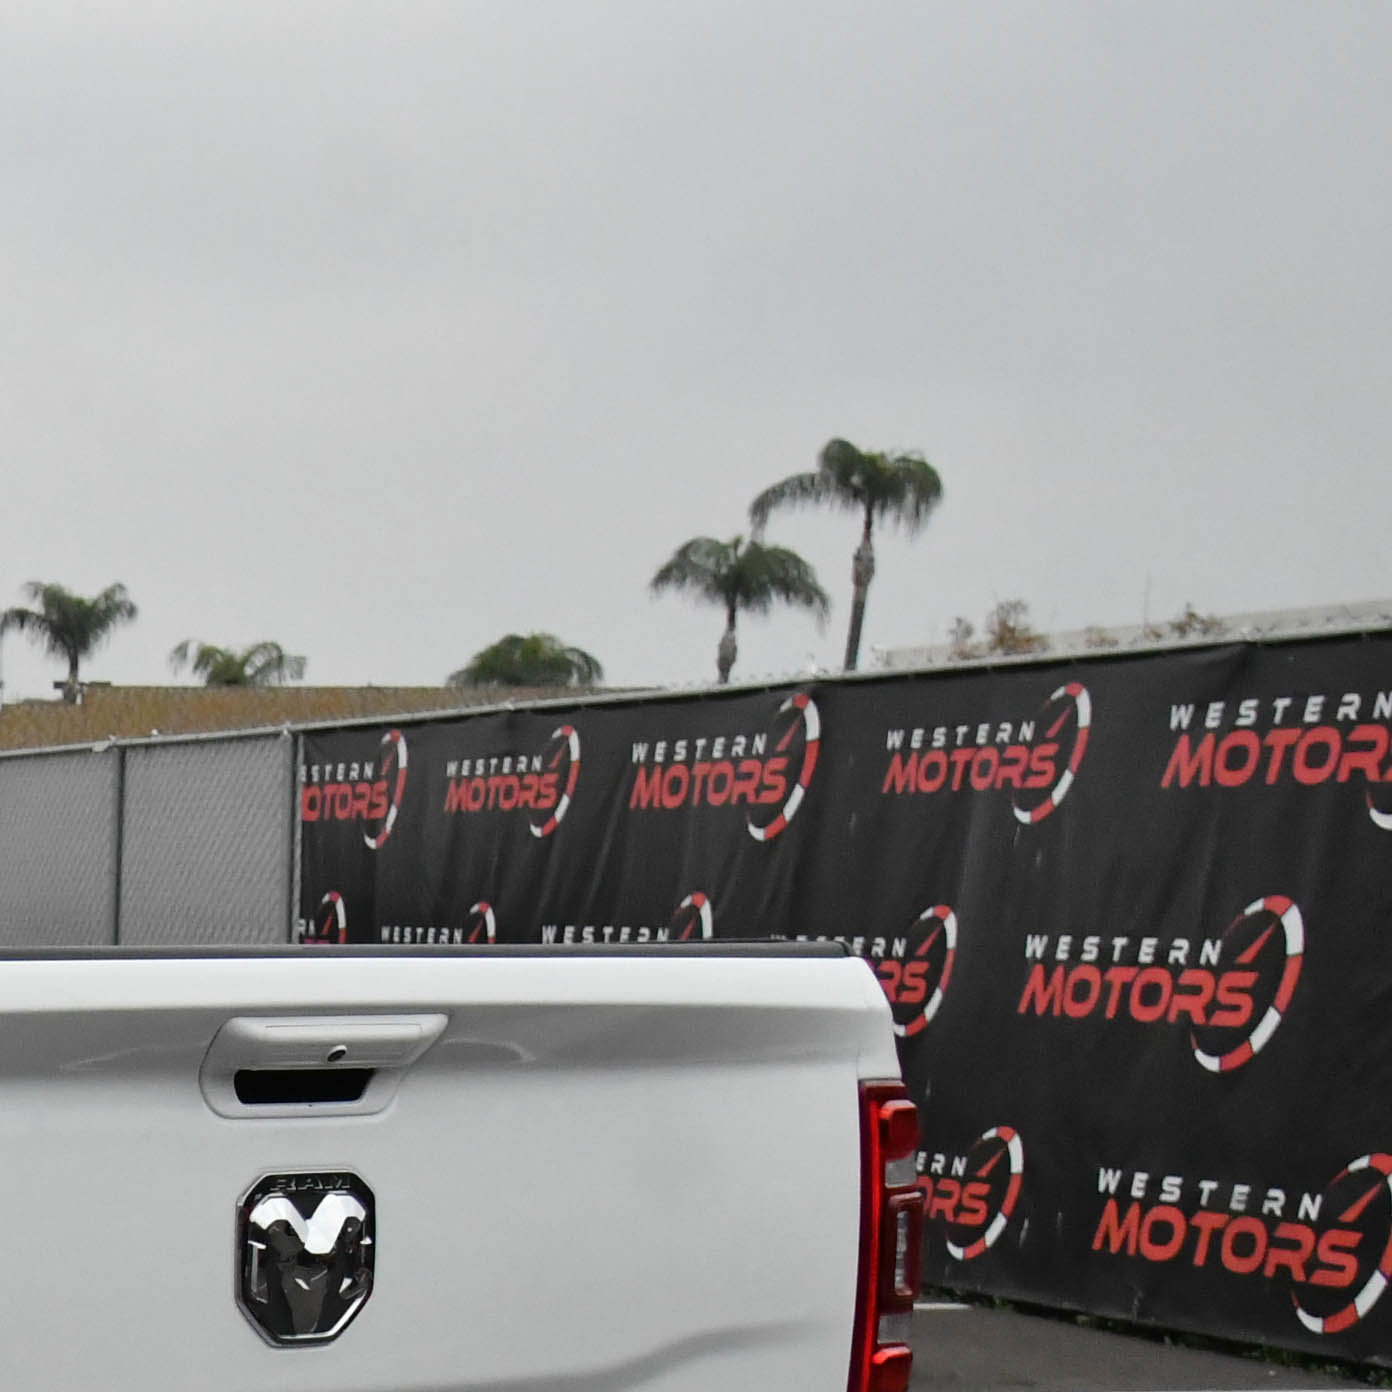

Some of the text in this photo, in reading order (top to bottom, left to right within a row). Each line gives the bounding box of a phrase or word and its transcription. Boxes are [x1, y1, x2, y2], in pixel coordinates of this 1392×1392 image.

[1170, 691, 1392, 731] WESTERN
[632, 733, 767, 764] WESTERN
[886, 720, 1035, 750] WESTERN
[300, 762, 373, 783] ESTERN
[446, 755, 542, 777] WESTERN
[882, 743, 1059, 794] MOTORS
[1161, 723, 1392, 788] MOTOR
[301, 780, 387, 821] OTORS
[444, 773, 558, 813] MOTORS
[630, 757, 789, 810] MOTORS
[381, 926, 463, 944] WESTERN
[1025, 934, 1222, 966] WESTERN
[1018, 963, 1259, 1027] MOTORS
[1098, 1167, 1323, 1222] WESTERN
[1092, 1199, 1364, 1288] MOTORS
